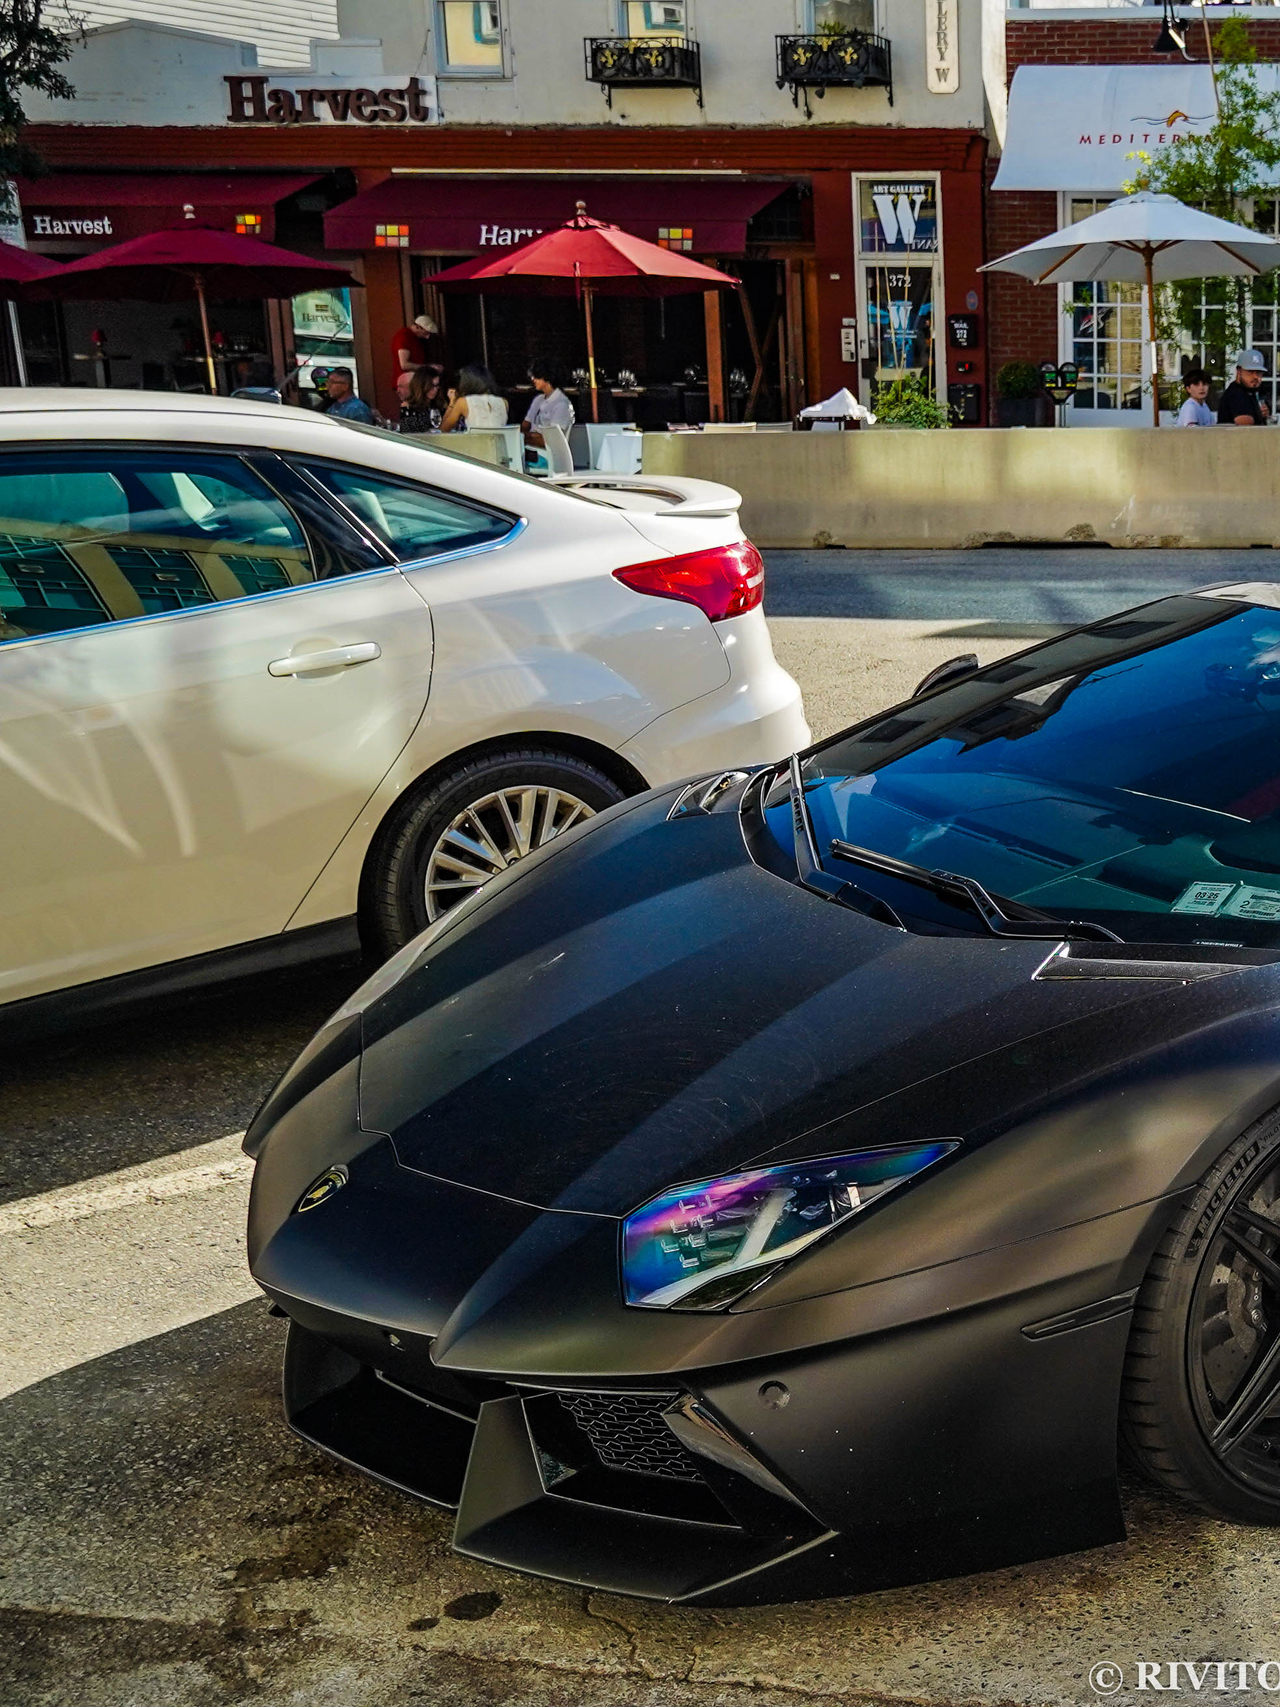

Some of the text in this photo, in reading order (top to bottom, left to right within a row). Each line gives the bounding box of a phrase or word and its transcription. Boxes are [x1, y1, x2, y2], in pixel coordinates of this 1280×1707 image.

[935, 67, 950, 83] W
[223, 75, 429, 123] Harvest
[873, 184, 888, 194] ART
[889, 184, 925, 194] GALLERY
[33, 215, 113, 235] Harvest
[872, 194, 926, 244] W
[889, 274, 912, 287] 372
[1197, 1143, 1259, 1234] MICHELIN
